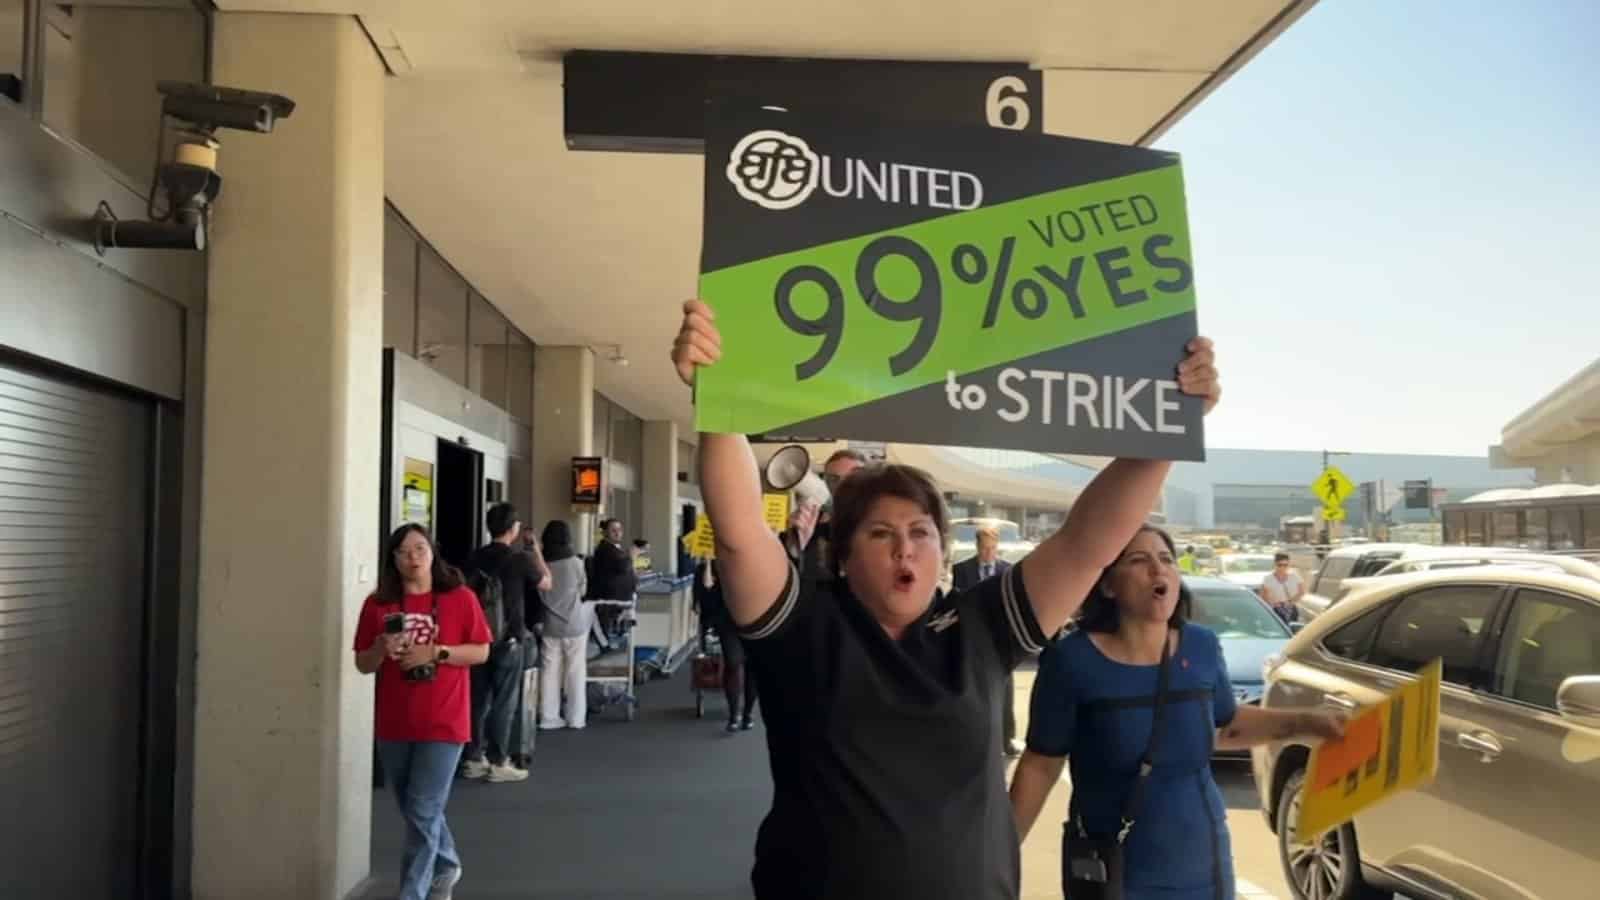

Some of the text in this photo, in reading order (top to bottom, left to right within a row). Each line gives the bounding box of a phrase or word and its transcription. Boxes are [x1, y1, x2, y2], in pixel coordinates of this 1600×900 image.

[985, 76, 1030, 131] 6
[821, 155, 983, 211] UNITED
[1028, 194, 1158, 249] VOTED
[774, 234, 1192, 380] 99% YES
[946, 368, 1186, 434] to STRIKE
